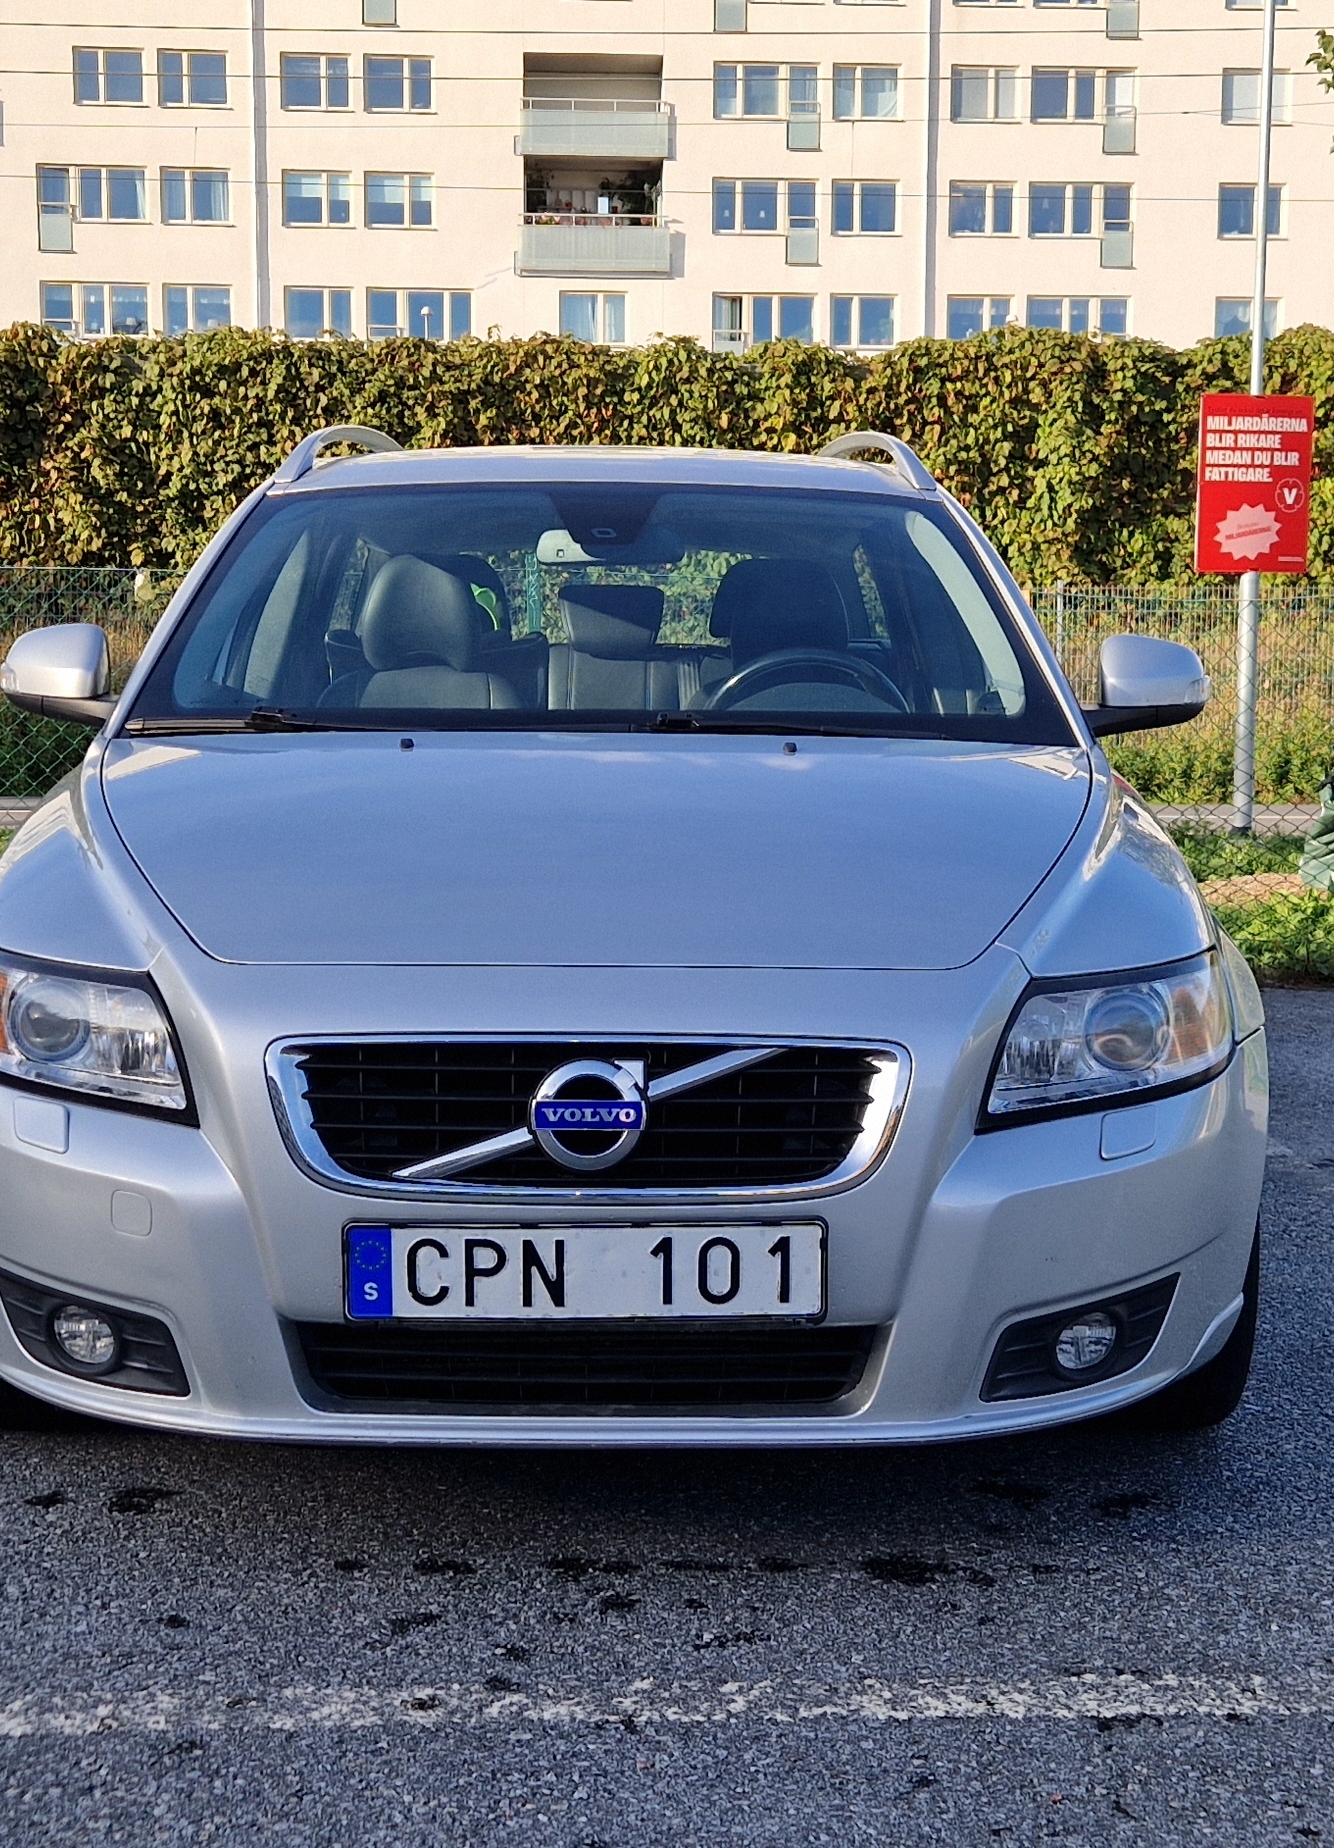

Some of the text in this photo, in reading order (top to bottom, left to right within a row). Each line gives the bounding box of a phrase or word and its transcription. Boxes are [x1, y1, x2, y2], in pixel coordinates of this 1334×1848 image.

[1207, 413, 1308, 432] MILJARDÄRERNA
[1206, 433, 1282, 448] BLIR RIKARE
[1205, 450, 1300, 466] MEDAN DU BLIR
[1205, 466, 1273, 482] FATTIGARE.
[1283, 487, 1297, 505] V
[541, 1108, 637, 1123] VOLVO
[407, 1235, 791, 1308] CPN 101
[364, 1282, 378, 1301] S
